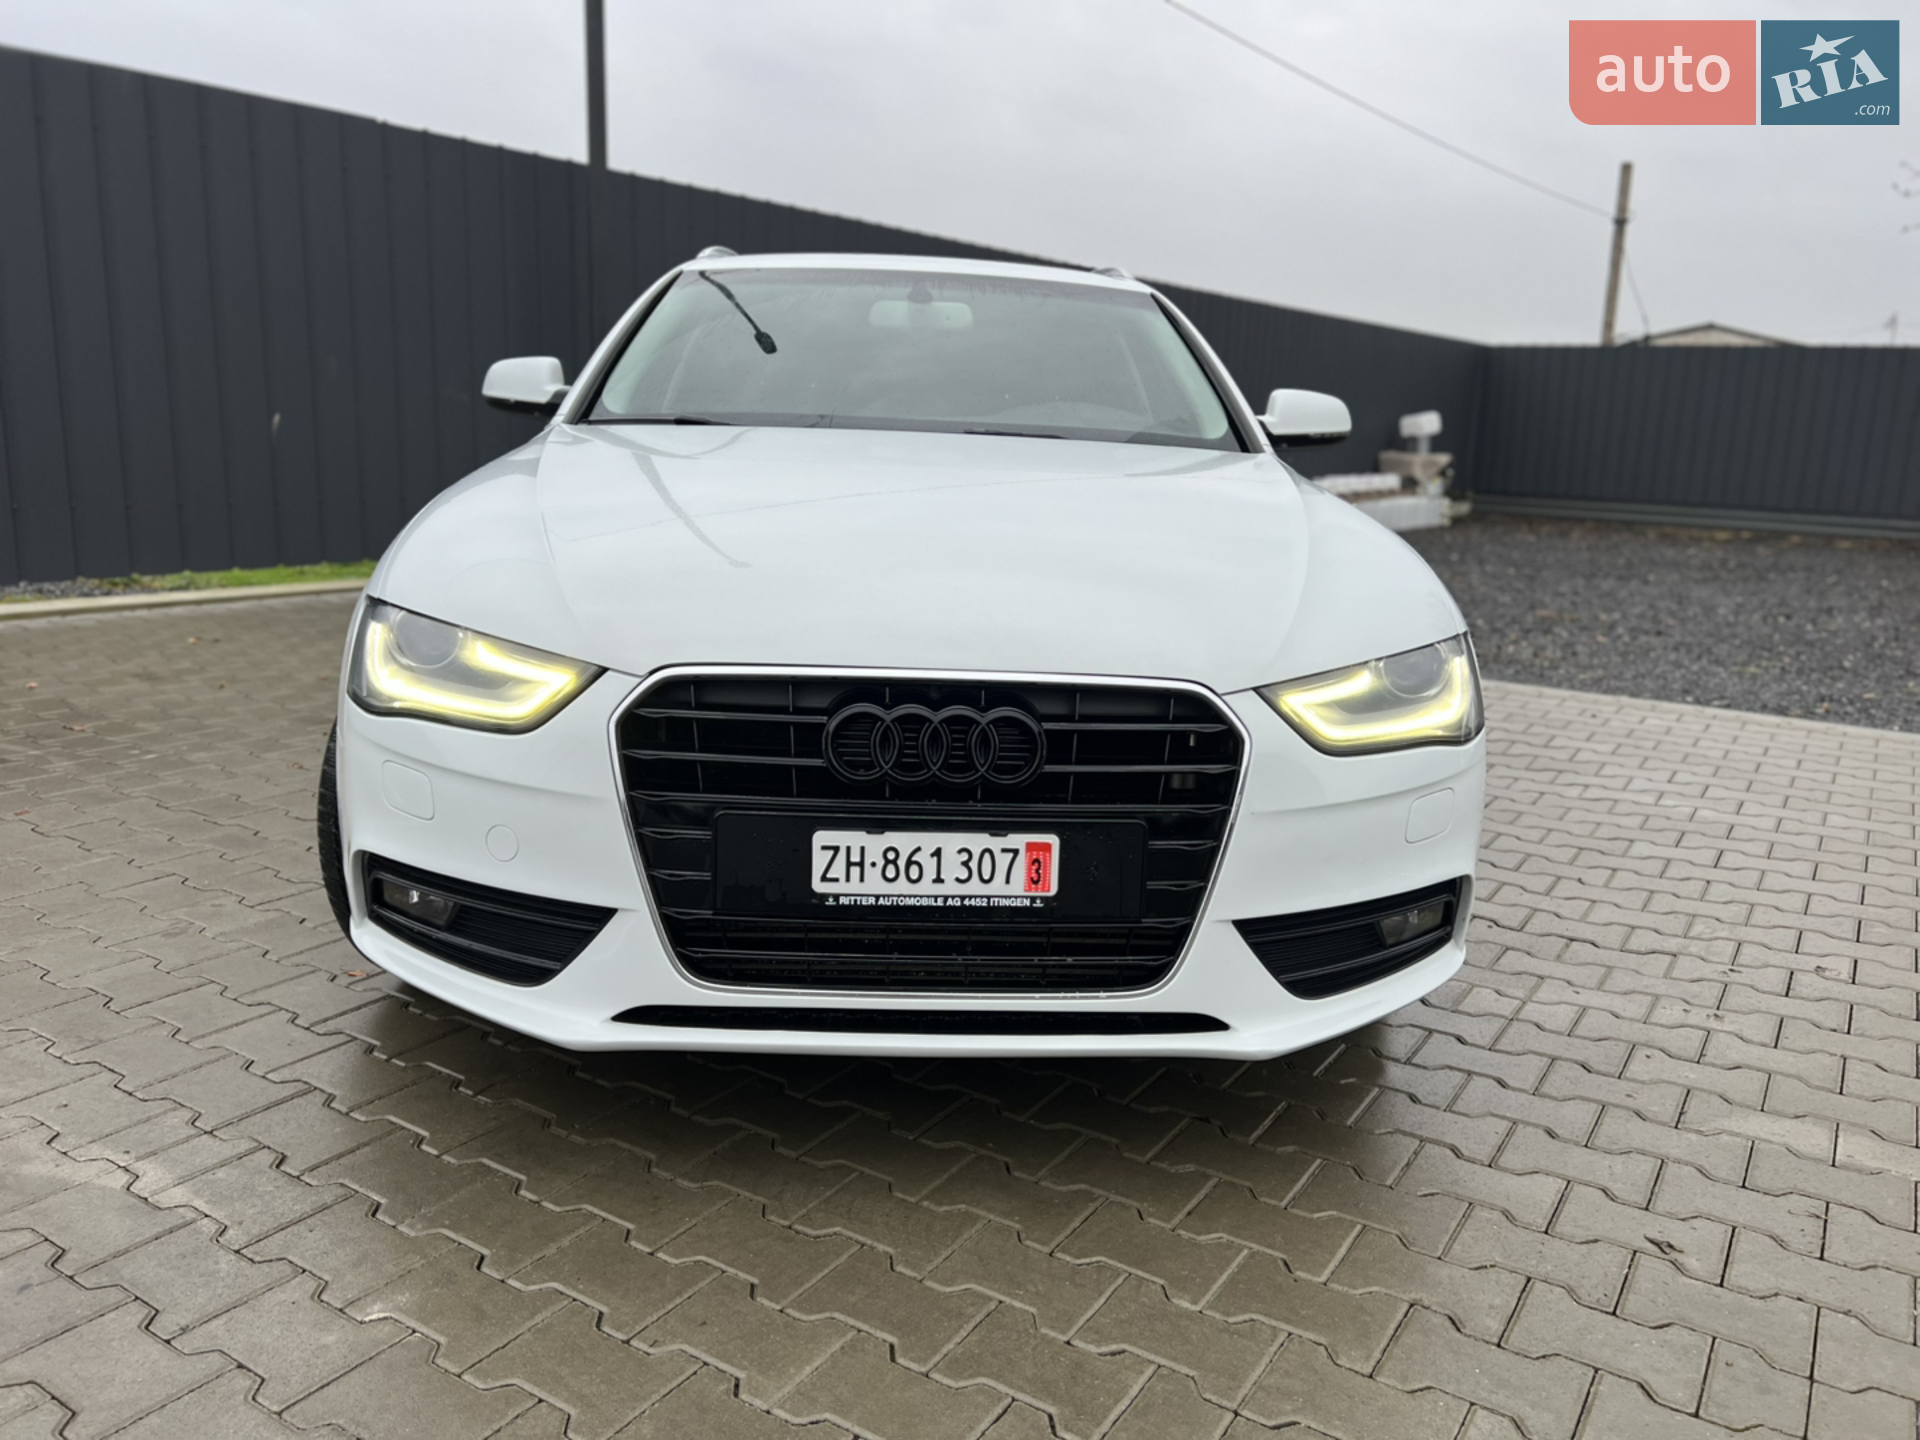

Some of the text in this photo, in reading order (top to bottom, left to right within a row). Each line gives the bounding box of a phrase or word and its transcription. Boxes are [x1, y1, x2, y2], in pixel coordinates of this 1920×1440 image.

[1030, 858, 1042, 885] 3
[839, 896, 1031, 907] RITTER AUTOMOBILE AG 4452 ITINGEN
